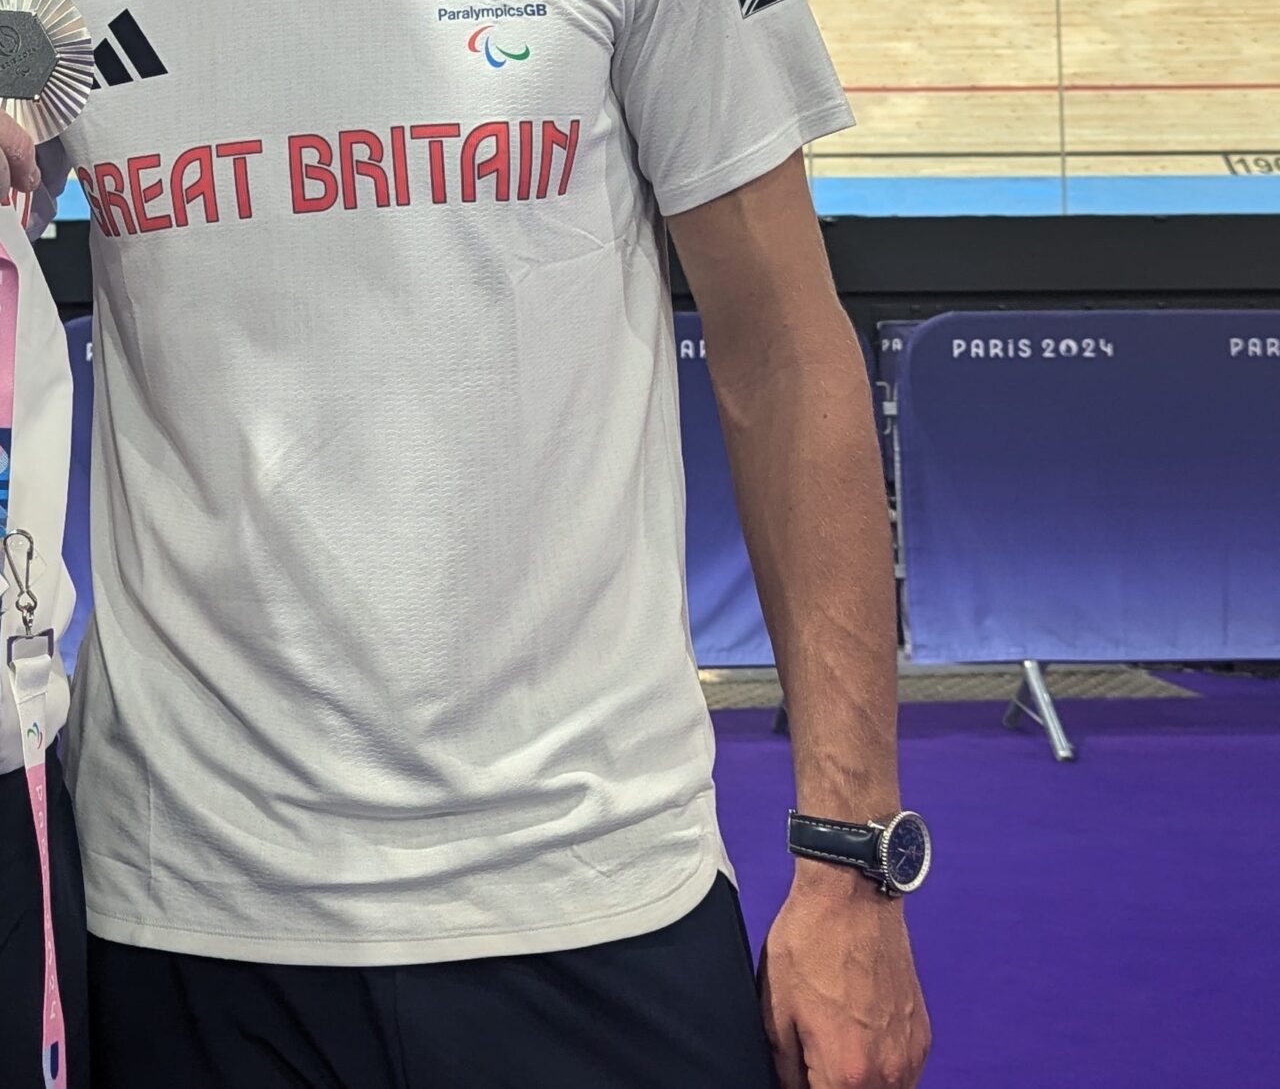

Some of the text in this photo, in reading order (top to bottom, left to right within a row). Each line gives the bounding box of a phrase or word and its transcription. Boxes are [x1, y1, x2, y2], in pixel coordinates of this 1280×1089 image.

[437, 3, 548, 21] ParalympicsGB
[287, 119, 580, 214] BRITAIN
[1041, 337, 1114, 357] 2024
